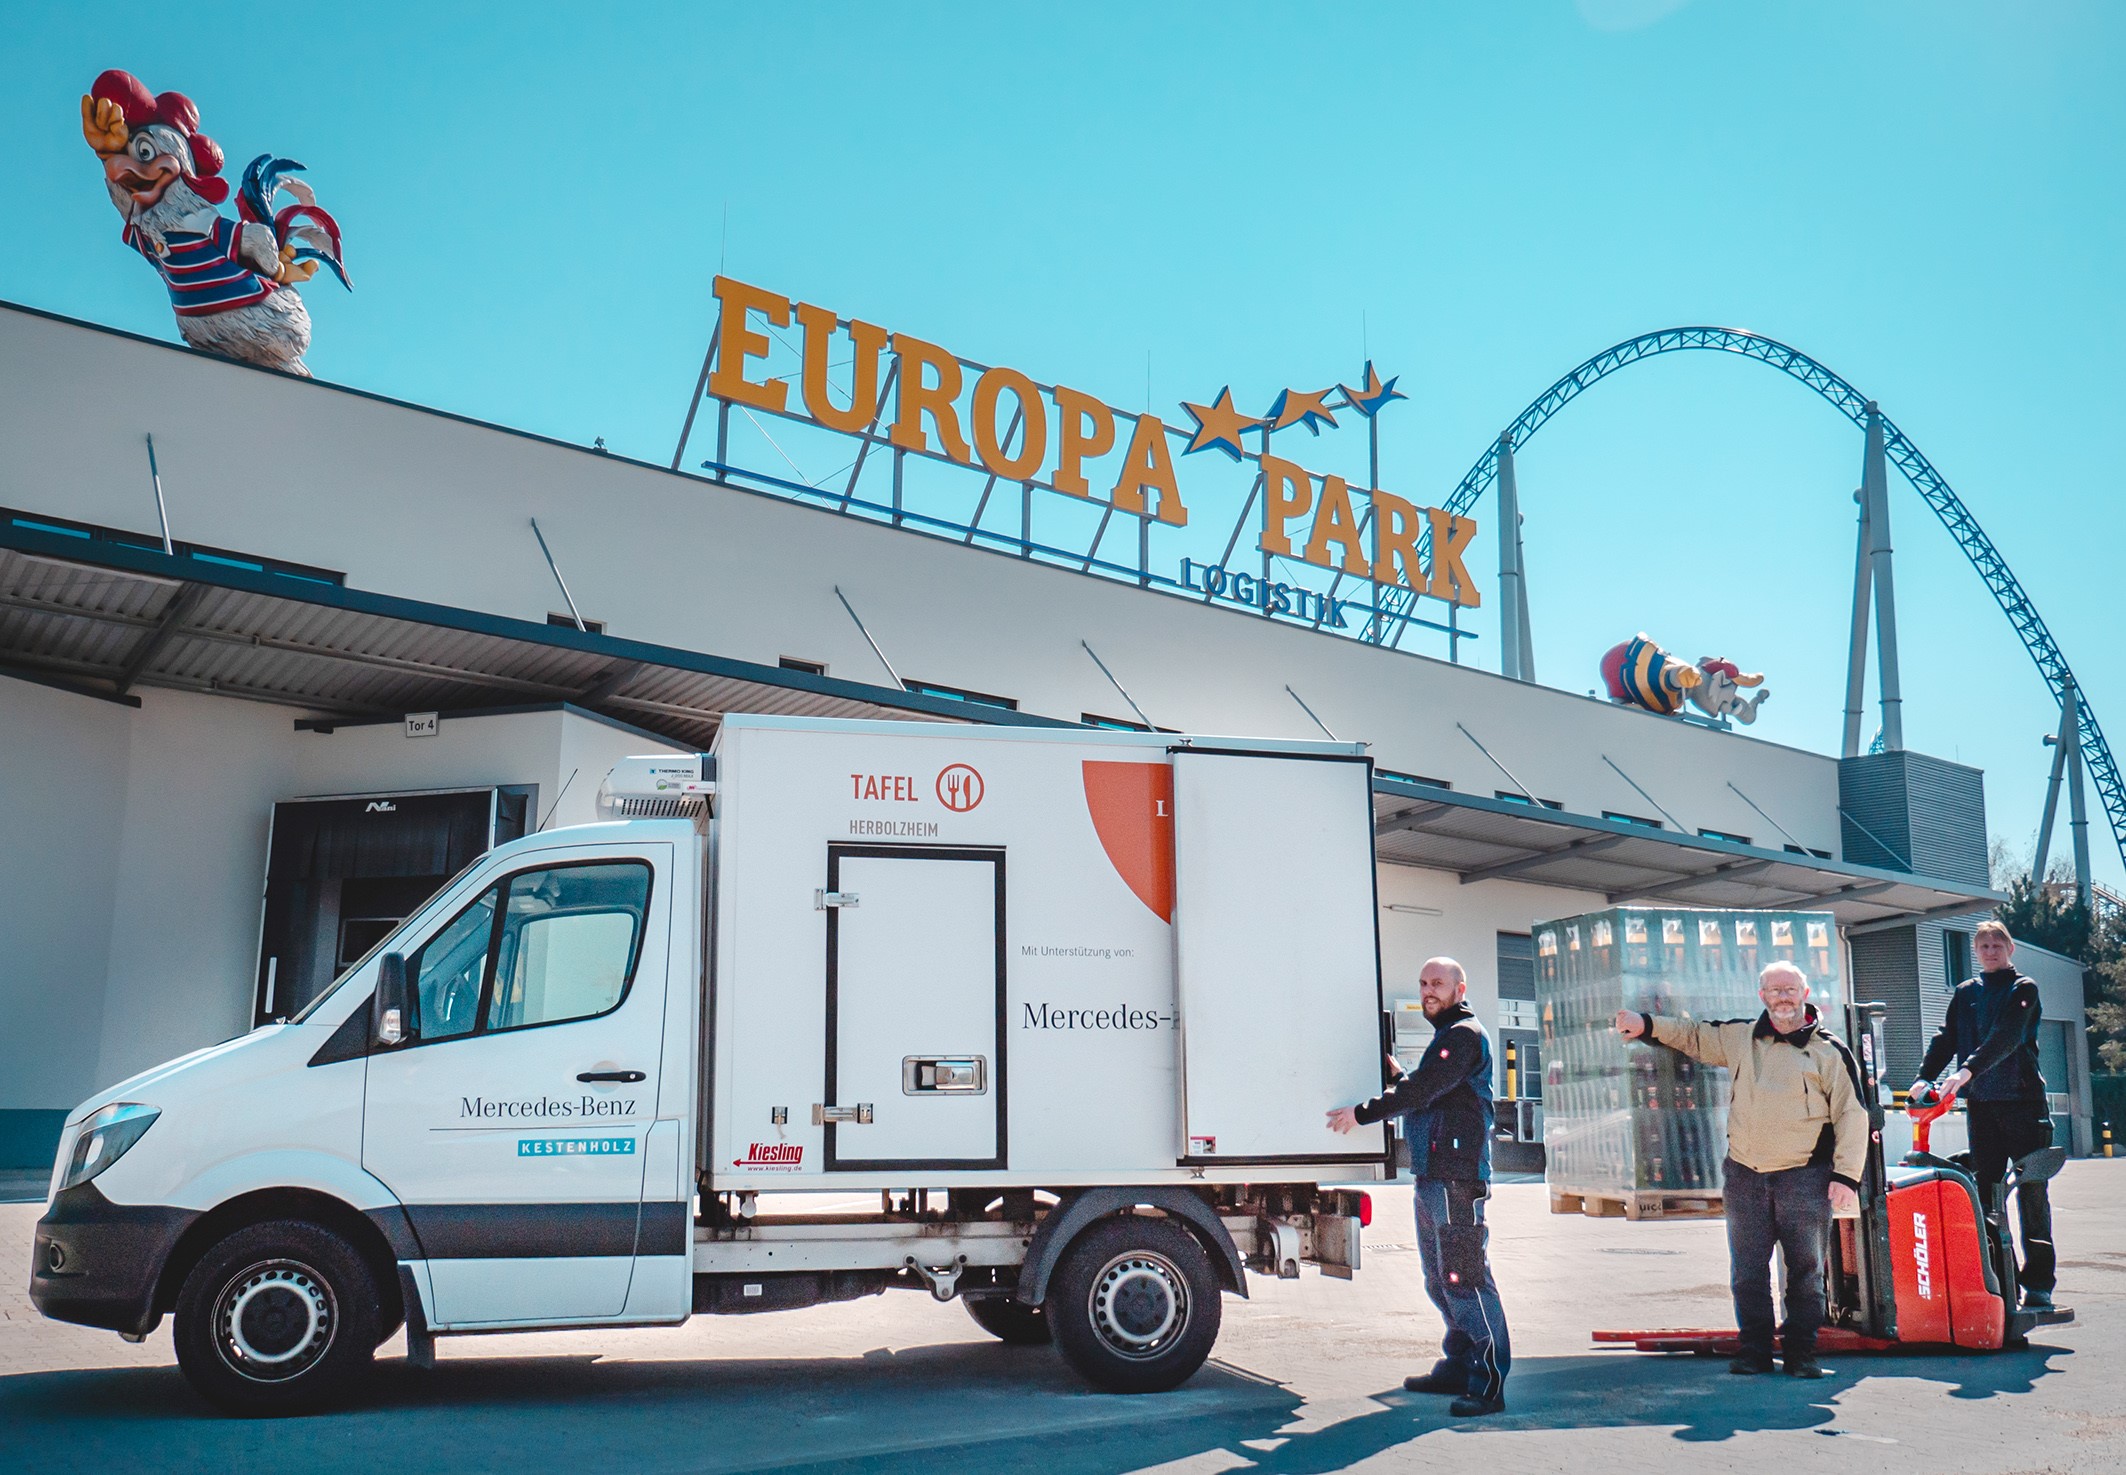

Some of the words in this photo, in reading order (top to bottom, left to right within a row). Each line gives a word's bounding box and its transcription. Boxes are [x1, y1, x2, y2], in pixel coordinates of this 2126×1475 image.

[707, 275, 1187, 528] EUROPA
[1256, 453, 1481, 609] PARK
[1180, 557, 1349, 629] LOGISTIK
[408, 720, 425, 731] Tor
[428, 719, 434, 730] 4
[851, 774, 919, 801] TAFEL
[850, 819, 938, 837] HERBOLZHEIM
[1021, 945, 1037, 957] Mit
[1041, 945, 1111, 959] Unterstützung
[1114, 949, 1135, 957] von:
[1022, 1002, 1173, 1030] Mercedes-
[460, 1096, 636, 1118] Mercedes-Benz
[521, 1140, 632, 1154] KESTENHOLZ
[748, 1143, 803, 1162] Kiesling
[1913, 1212, 1931, 1300] SCHÖLER
